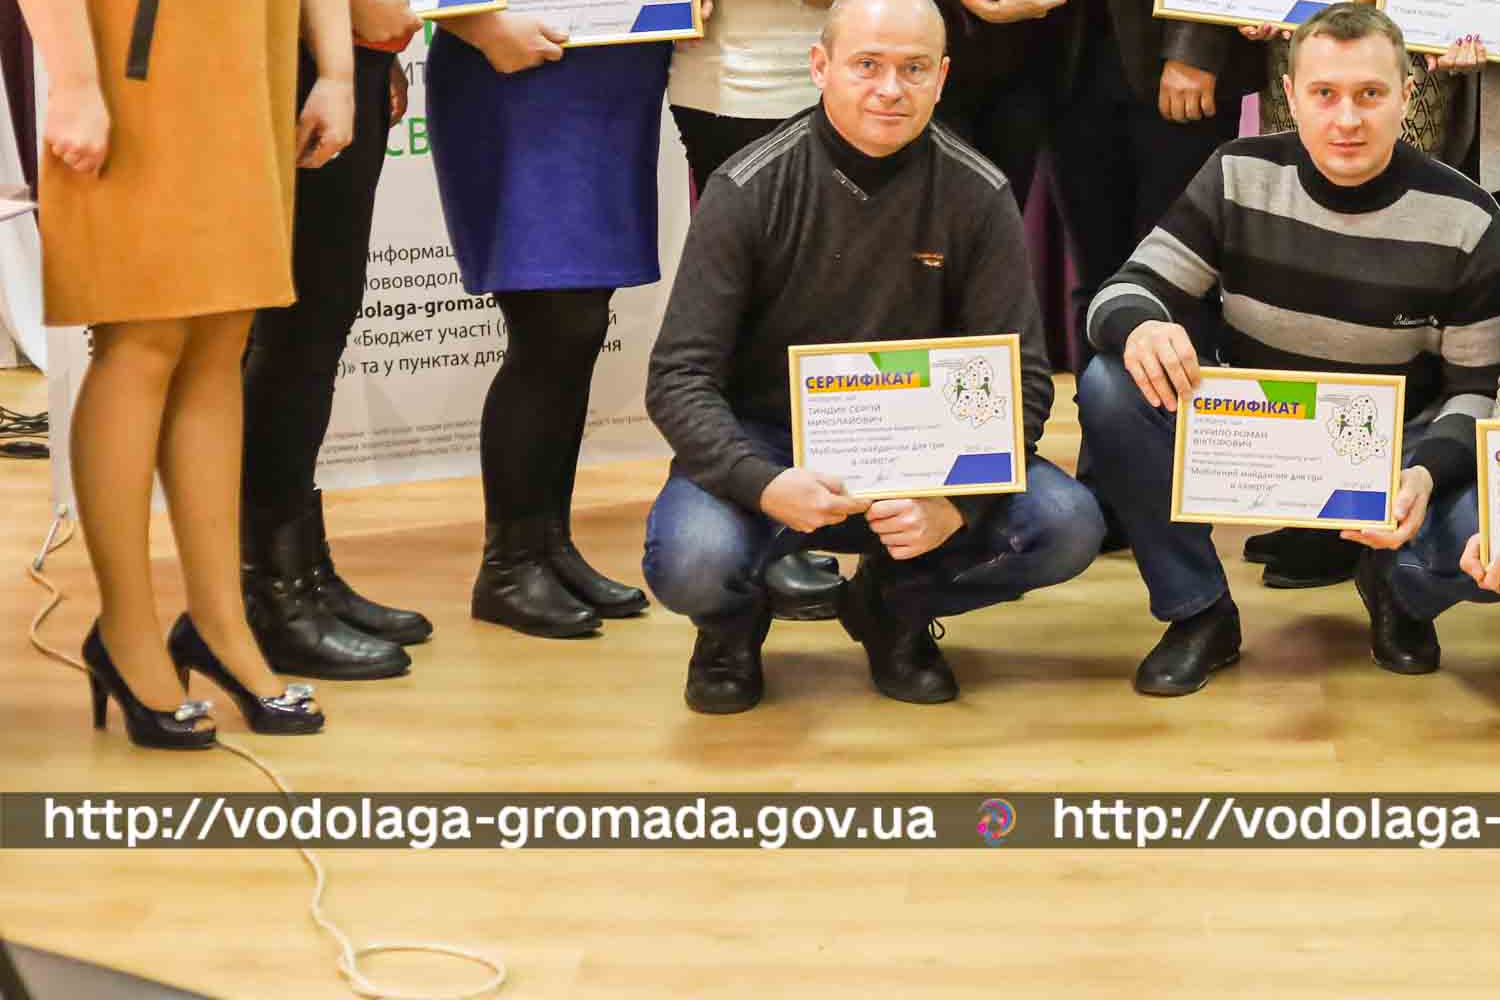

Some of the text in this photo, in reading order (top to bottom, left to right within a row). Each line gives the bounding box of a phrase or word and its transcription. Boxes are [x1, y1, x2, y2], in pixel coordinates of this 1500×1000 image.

[366, 272, 462, 292] ововодол
[353, 328, 433, 347] «Бюджет
[438, 319, 492, 344] участі
[360, 359, 379, 375] та
[384, 359, 394, 377] у
[399, 351, 470, 375] пунктах
[473, 349, 505, 369] для
[805, 371, 915, 390] СЕРТИФІКАТ
[1193, 397, 1300, 416] СЕРТИФІКАТ
